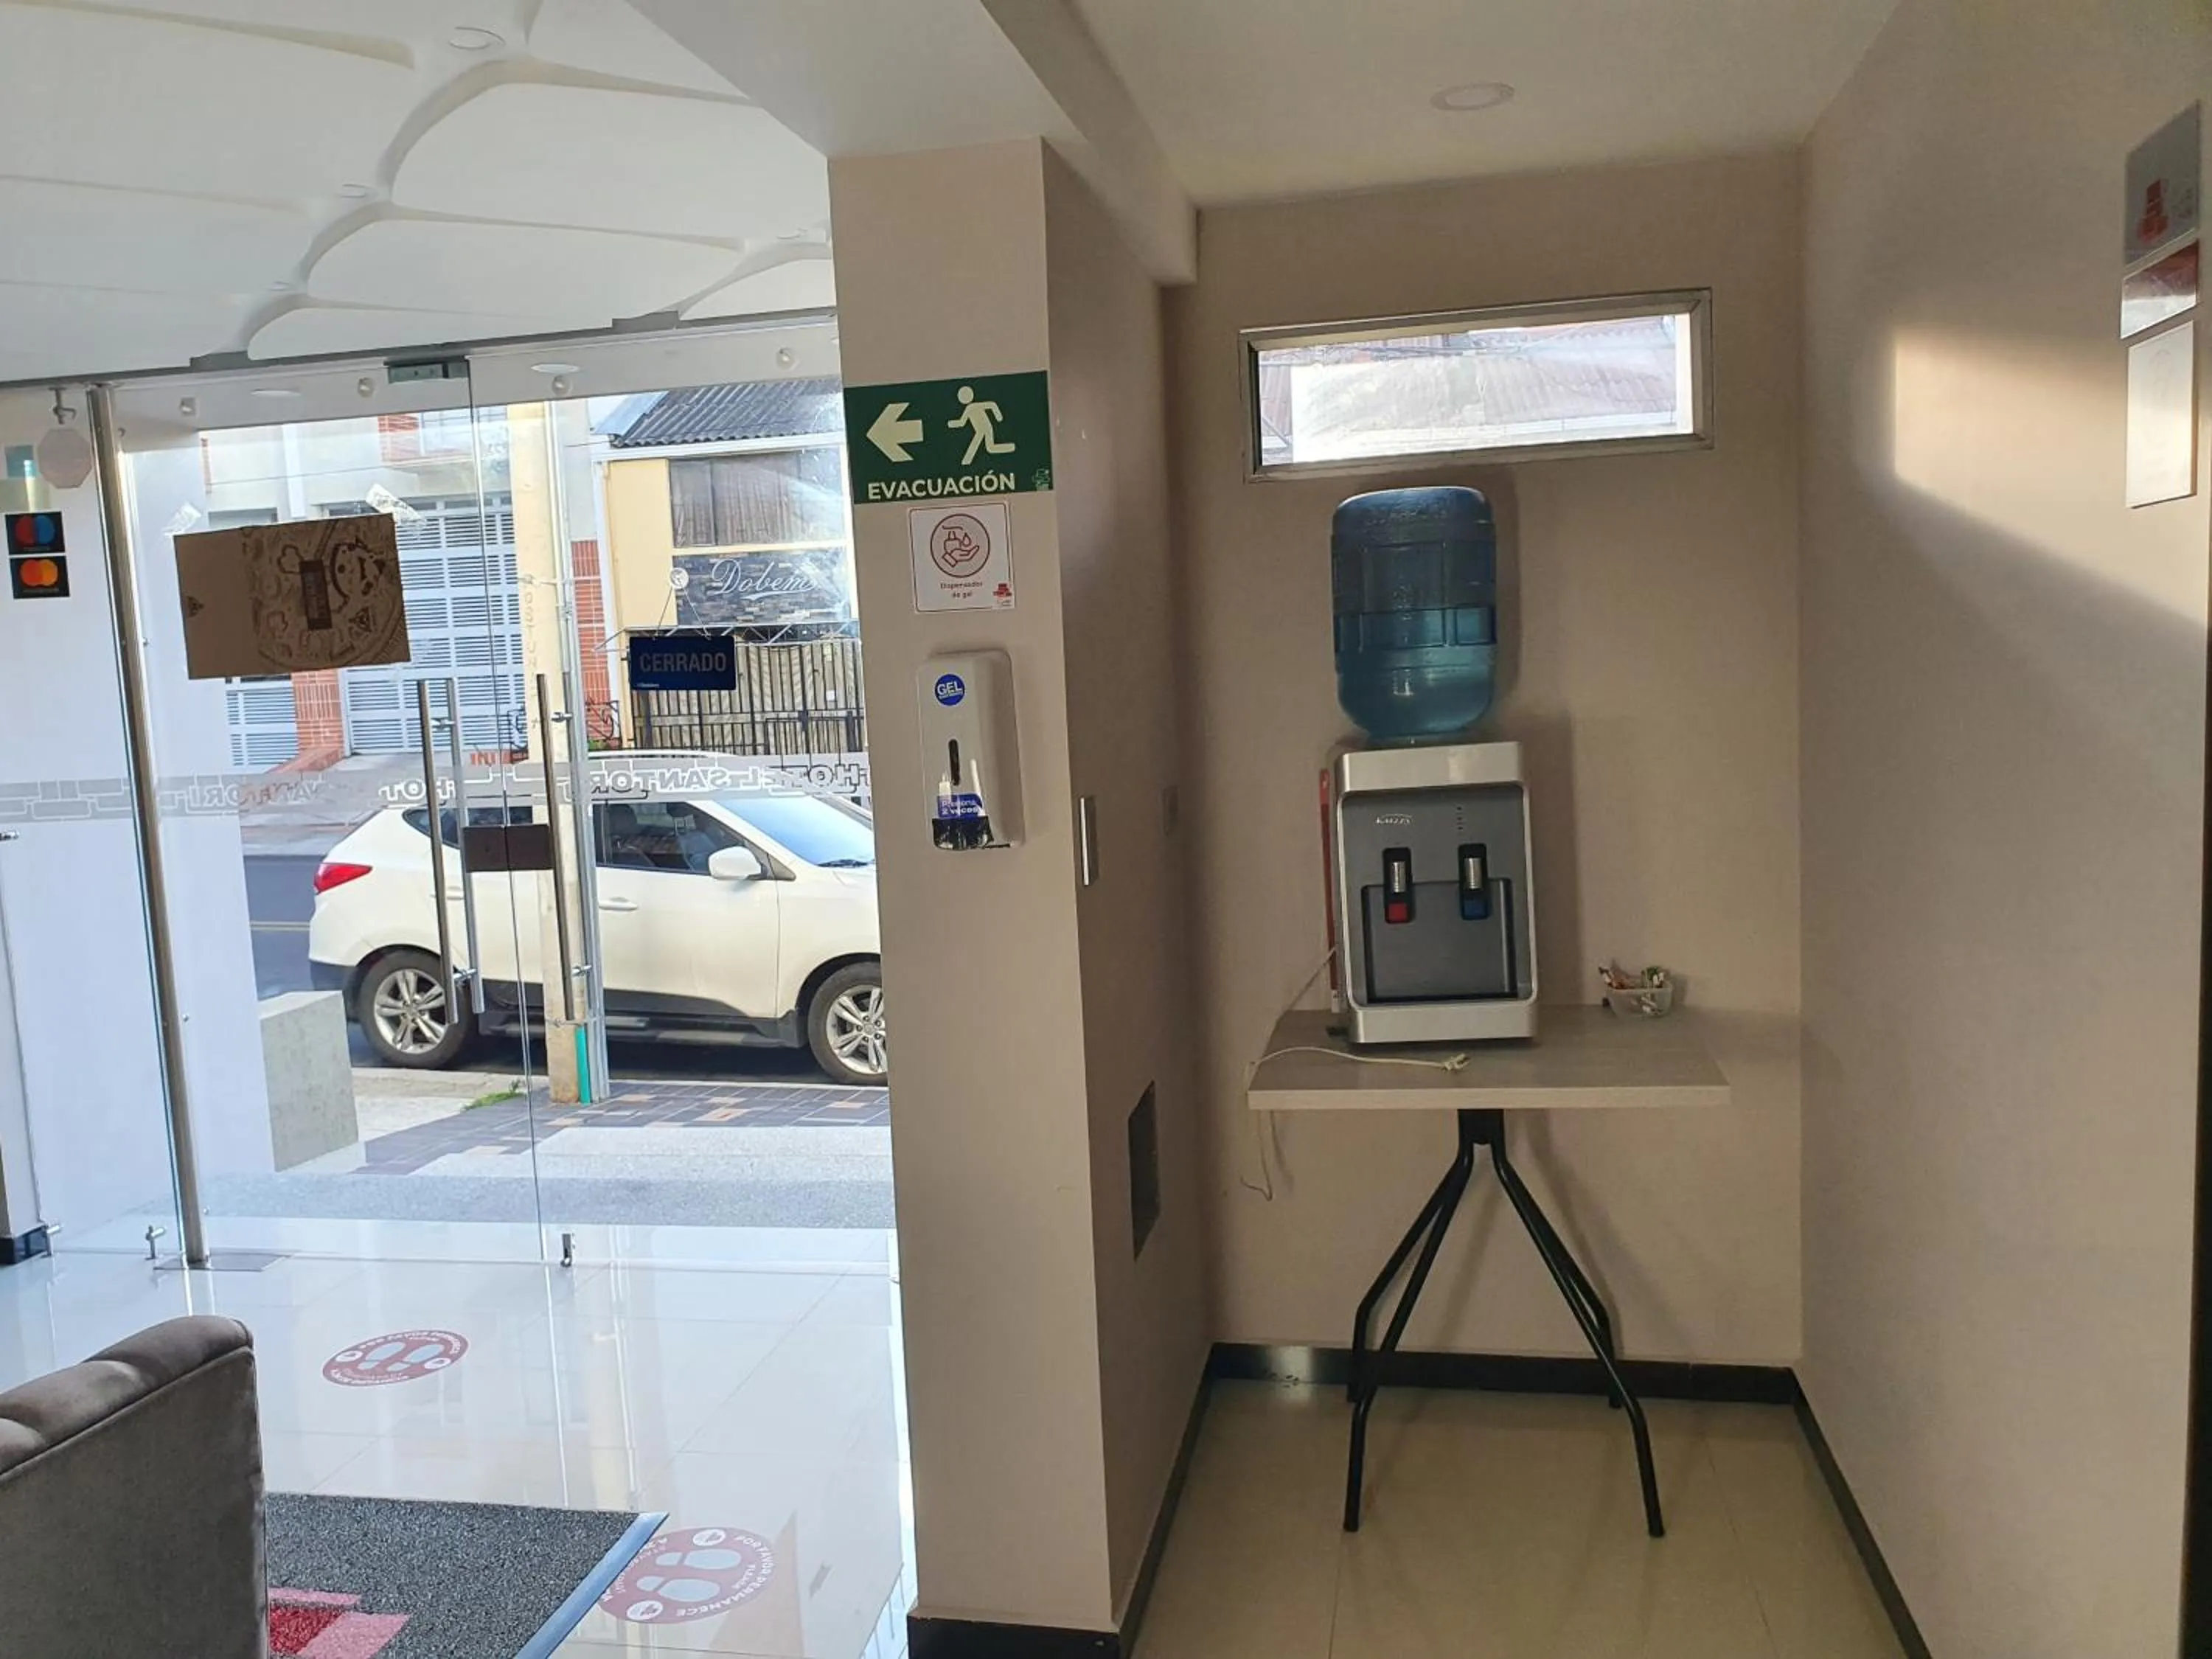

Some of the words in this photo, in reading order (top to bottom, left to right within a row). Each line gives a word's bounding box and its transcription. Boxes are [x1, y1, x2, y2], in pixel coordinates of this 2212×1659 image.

[868, 470, 1016, 500] EVACUACIÓN
[639, 652, 727, 672] CERRADO
[937, 681, 963, 695] GEL
